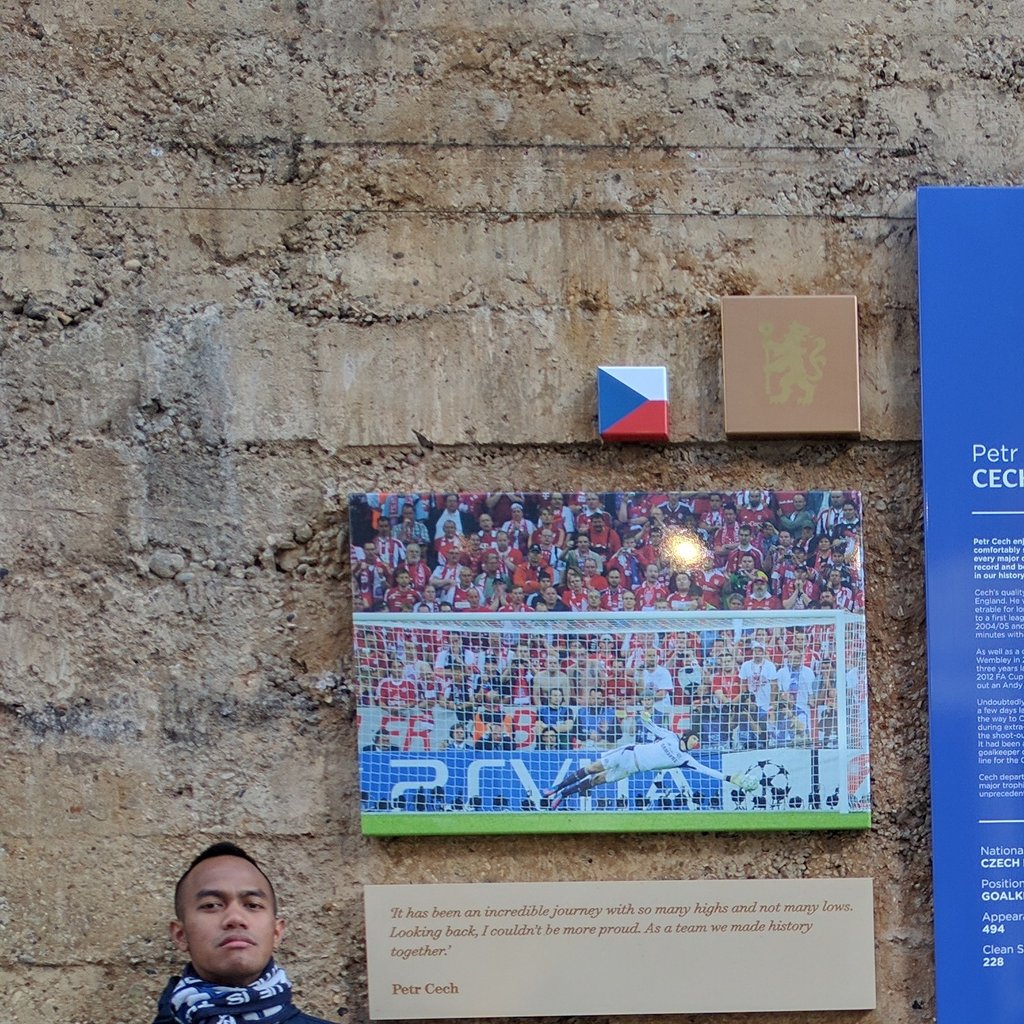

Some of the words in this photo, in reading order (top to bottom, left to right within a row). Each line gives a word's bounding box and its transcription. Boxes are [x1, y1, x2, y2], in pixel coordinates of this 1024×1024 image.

[972, 444, 1018, 462] Petr
[974, 546, 1020, 555] comfortably
[980, 858, 1020, 868] CZECH
[406, 906, 429, 918] has
[432, 906, 462, 917] been
[484, 905, 549, 916] incredible
[551, 907, 603, 919] journey
[605, 904, 636, 915] with
[655, 906, 691, 917] many
[694, 902, 728, 917] highs
[731, 902, 757, 913] and
[759, 902, 781, 913] not
[784, 904, 819, 916] many
[822, 901, 853, 912] lows.
[390, 925, 442, 940] Looking
[445, 925, 479, 939] back,
[483, 925, 488, 936] I
[490, 924, 542, 936] couldn't
[546, 924, 560, 935] be
[598, 923, 641, 937] proud.
[644, 922, 661, 933] As
[676, 922, 708, 933] team
[730, 921, 765, 932] made
[768, 920, 812, 935] history
[982, 925, 1005, 934] 494
[983, 945, 1014, 954] Clean
[983, 957, 1004, 967] 228
[392, 984, 421, 994] Petr
[425, 983, 459, 994] Cech
